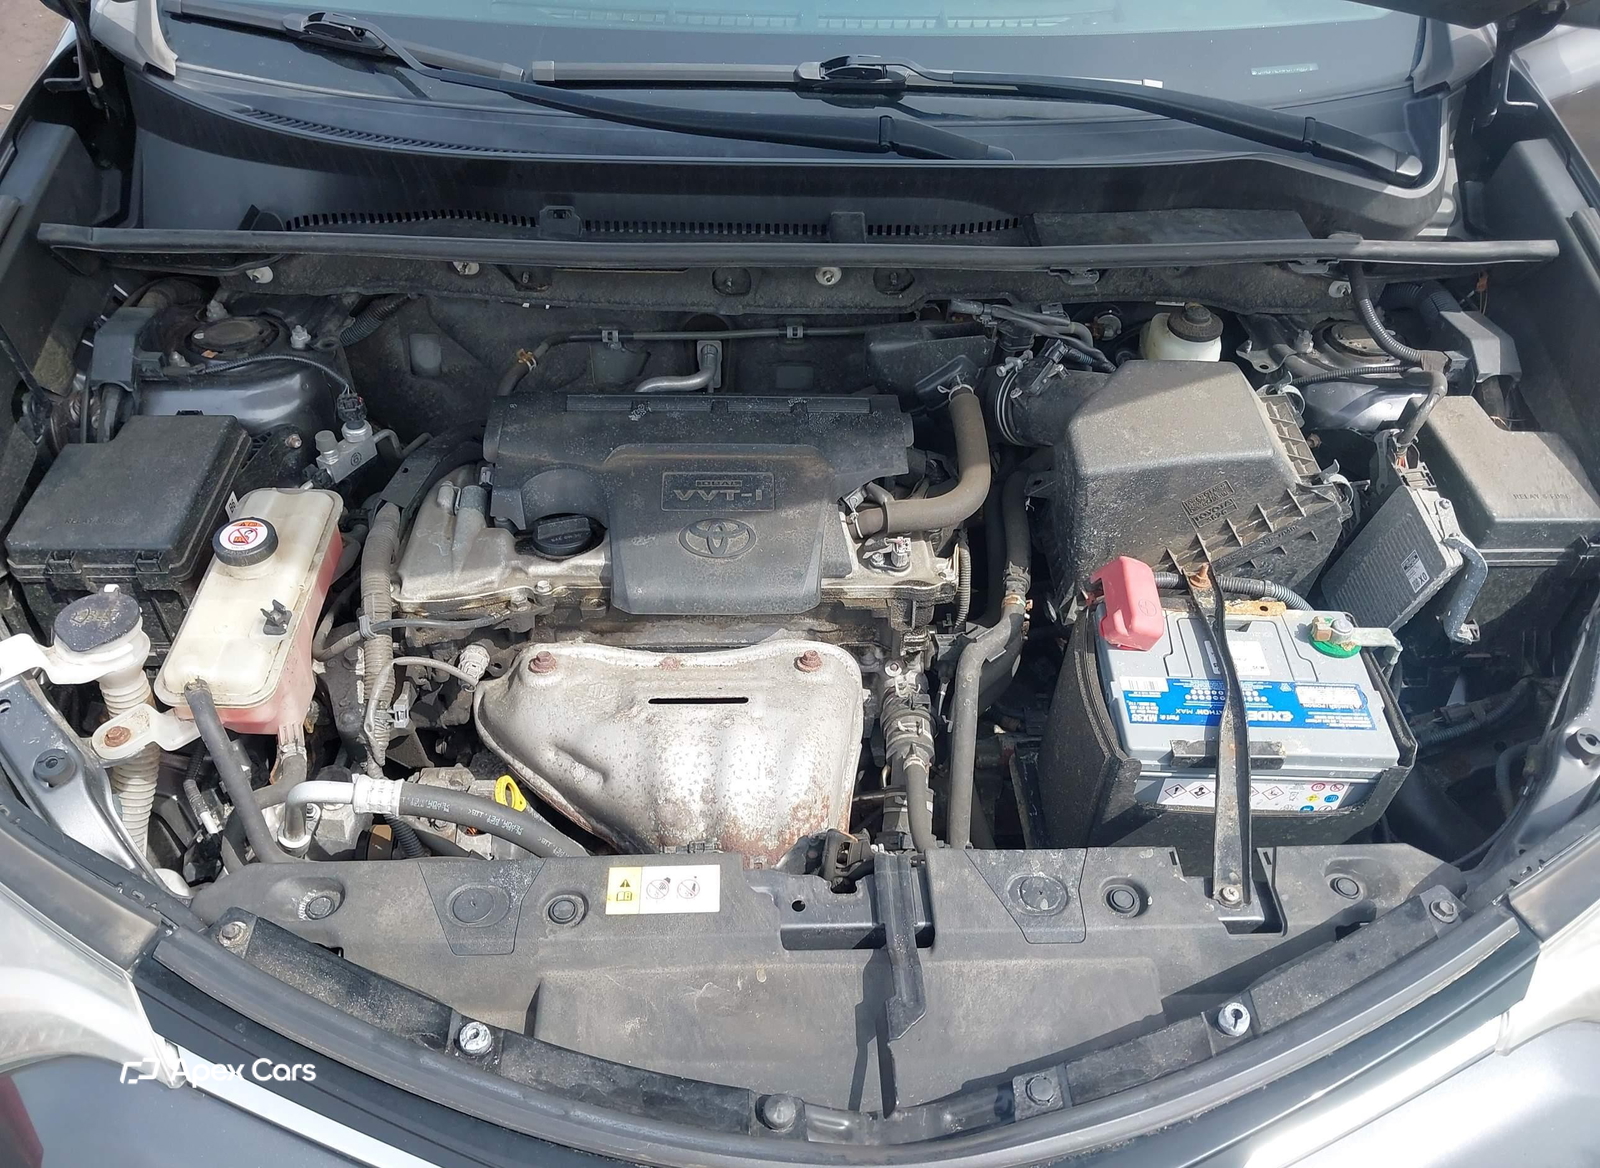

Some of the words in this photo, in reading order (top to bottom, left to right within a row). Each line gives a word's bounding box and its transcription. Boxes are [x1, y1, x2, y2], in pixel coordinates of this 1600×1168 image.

[1195, 499, 1233, 521] TOYOTA
[1131, 713, 1158, 722] MX35
[1246, 710, 1294, 721] EXIDE
